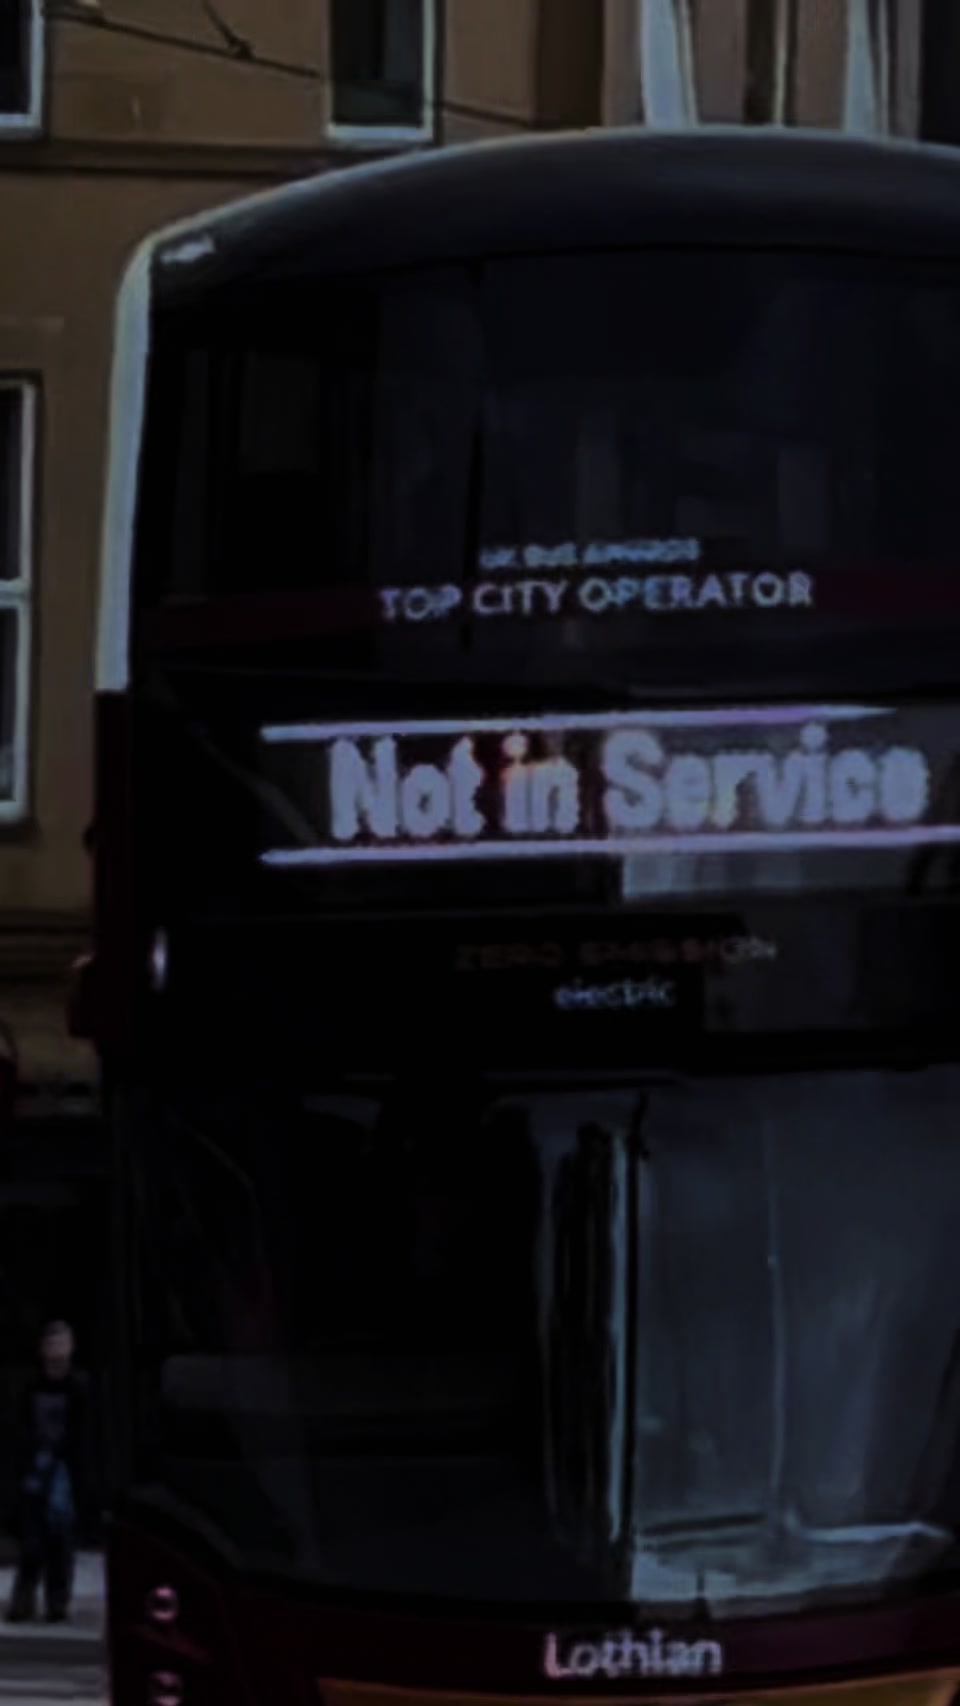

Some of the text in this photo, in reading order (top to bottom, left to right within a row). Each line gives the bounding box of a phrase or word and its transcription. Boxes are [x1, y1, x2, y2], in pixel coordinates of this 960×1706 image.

[377, 569, 815, 622] TOP CITY OPERATOR
[329, 721, 931, 841] Not in Service
[543, 1627, 724, 1679] Lothian
